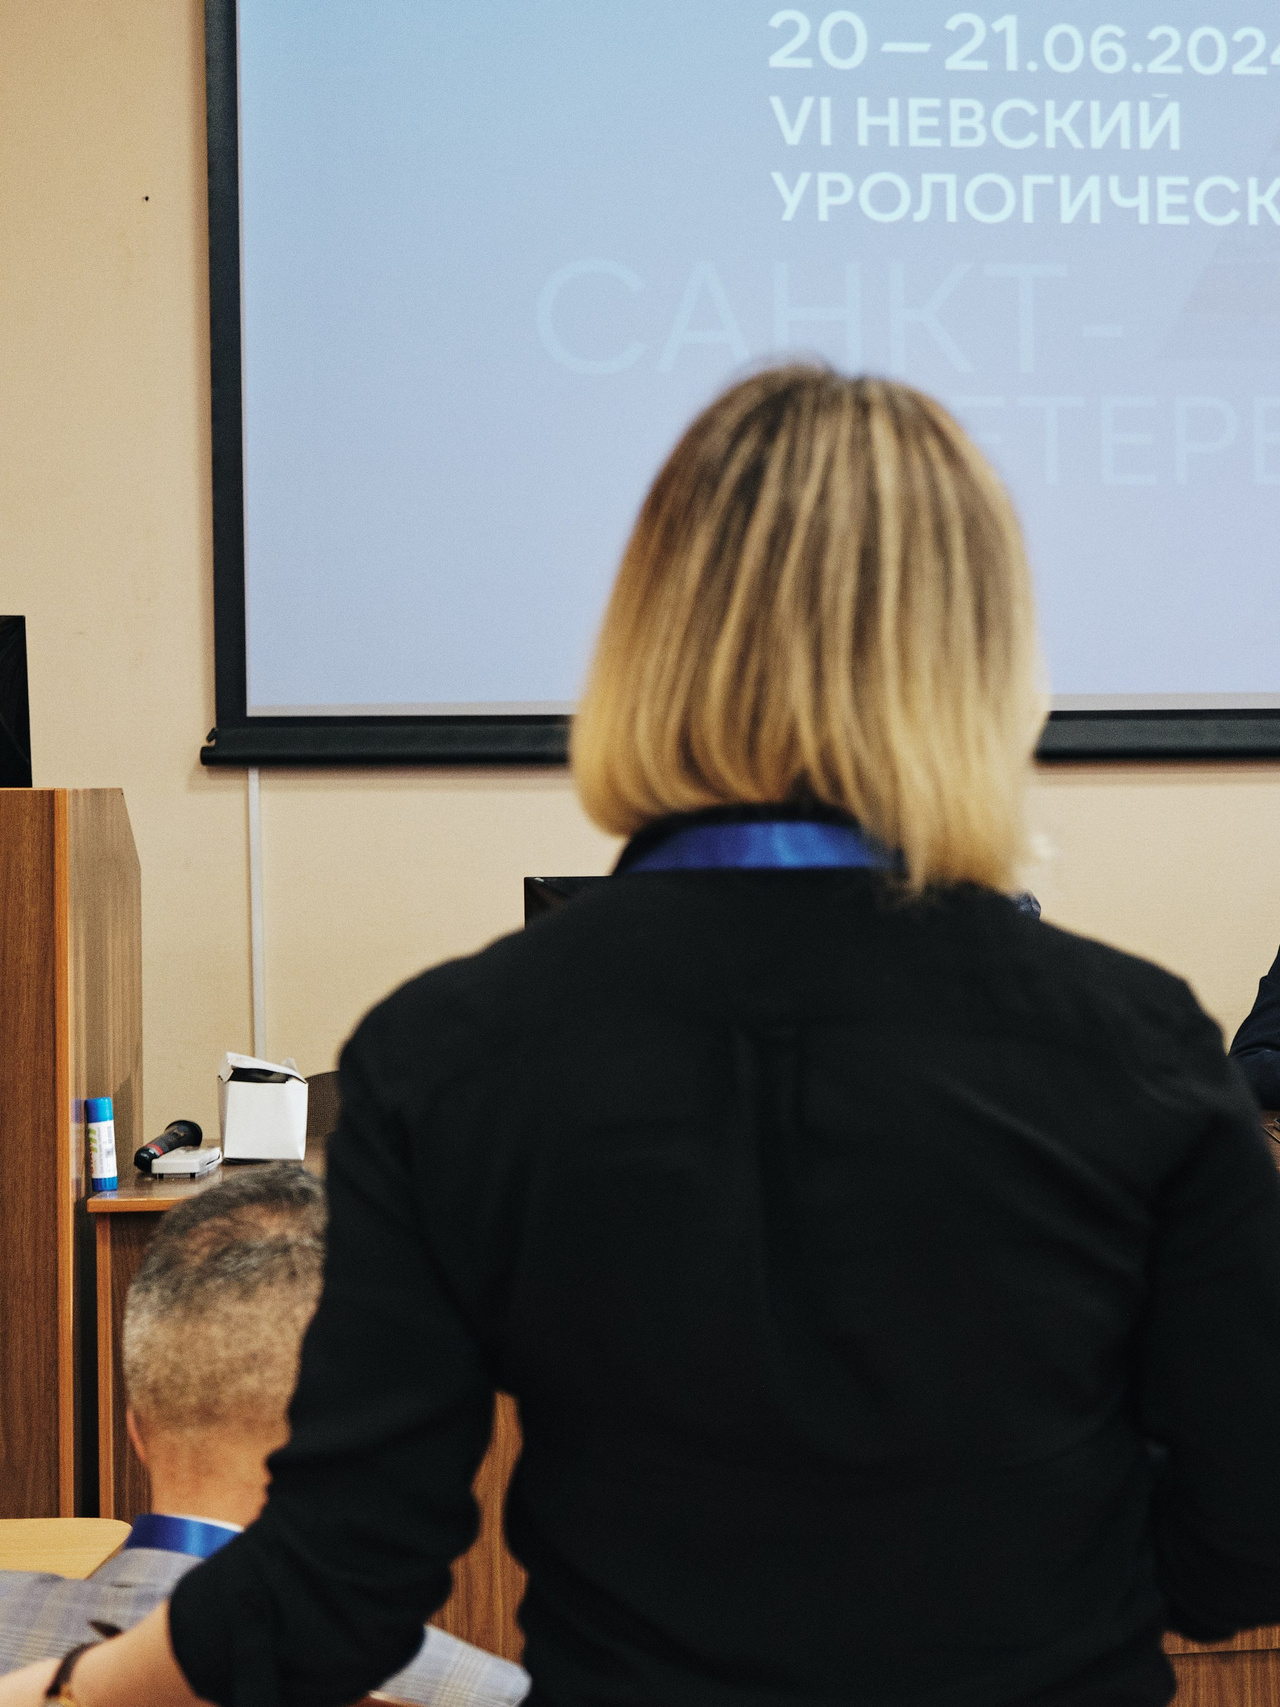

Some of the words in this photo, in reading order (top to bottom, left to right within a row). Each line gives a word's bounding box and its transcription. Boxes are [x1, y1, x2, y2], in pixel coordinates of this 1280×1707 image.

[769, 96, 834, 146] VI
[857, 94, 1181, 151] НЕВСКИЙ
[535, 258, 1124, 376] САНКТ-
